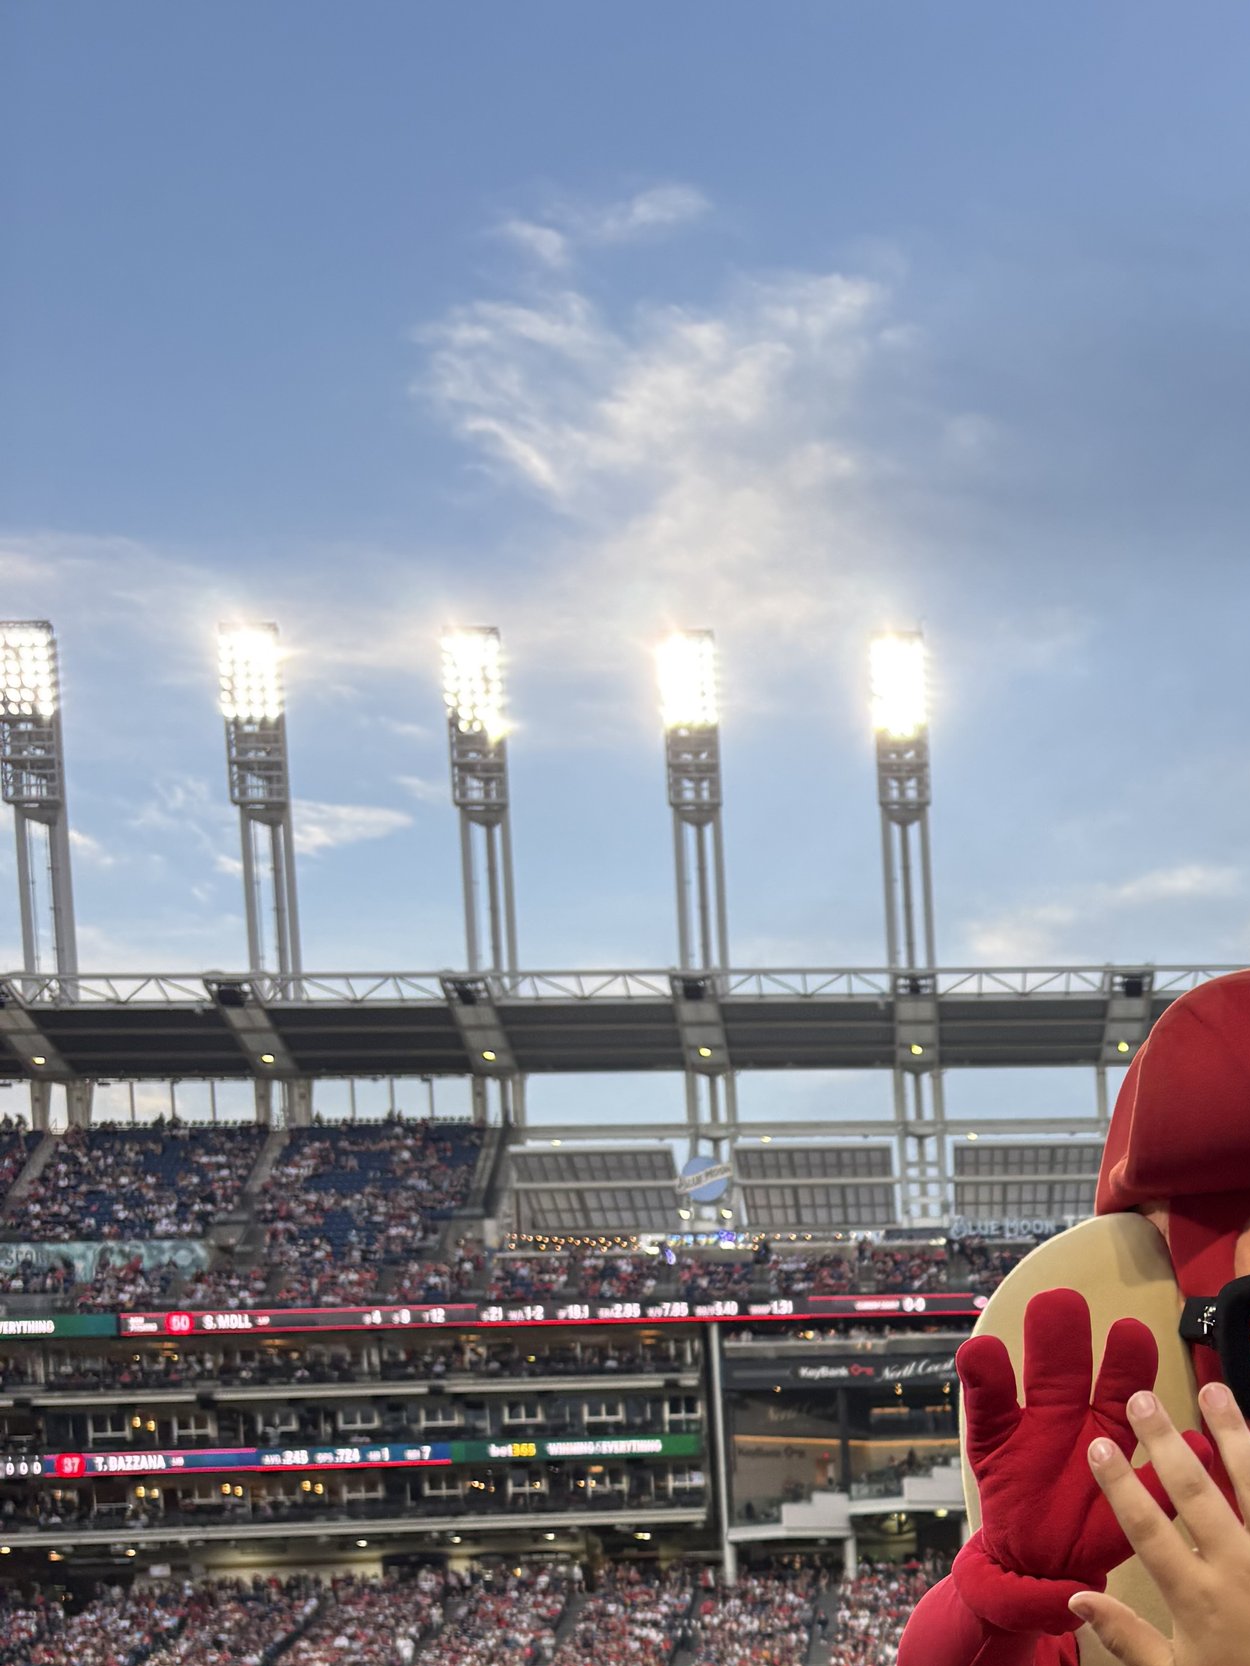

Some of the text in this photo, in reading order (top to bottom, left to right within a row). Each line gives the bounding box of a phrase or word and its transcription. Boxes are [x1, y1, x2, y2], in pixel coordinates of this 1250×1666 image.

[950, 1215, 999, 1239] BLUE
[1004, 1218, 1056, 1239] MOON
[0, 1319, 55, 1335] VERYTHING
[799, 1364, 849, 1380] KeyBank
[487, 1442, 537, 1458] bet365
